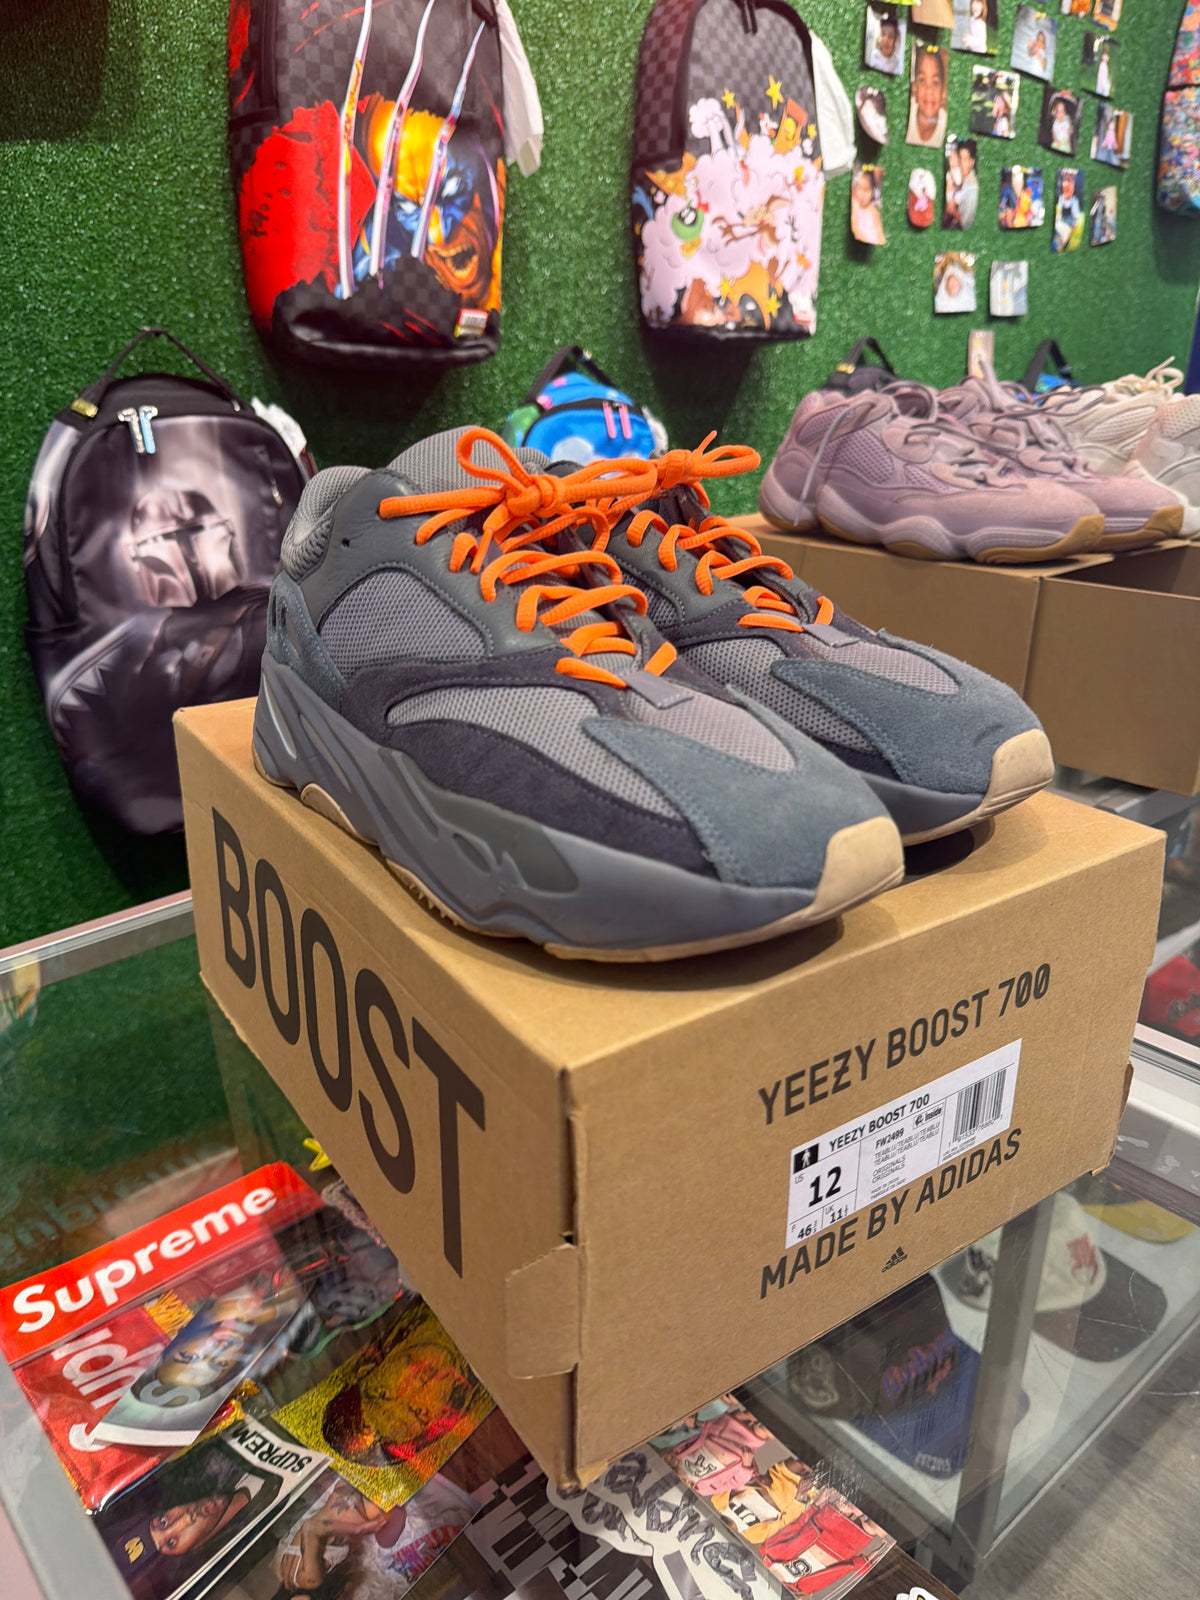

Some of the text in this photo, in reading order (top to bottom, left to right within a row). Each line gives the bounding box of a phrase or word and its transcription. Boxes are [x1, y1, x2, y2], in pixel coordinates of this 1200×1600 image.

[212, 806, 485, 1278] BOOST
[758, 962, 1051, 1125] YEEZY BOOST 700
[829, 1093, 930, 1152] YEEZY BOOST 700
[875, 1127, 905, 1150] FW2499
[794, 1173, 804, 1184] US
[808, 1166, 843, 1207] 12
[871, 1163, 906, 1184] ORIGINALS
[873, 1155, 906, 1176] ORIGINALS
[760, 1128, 1021, 1299] MADE BY ADIDAS
[13, 1186, 277, 1334] Supreme
